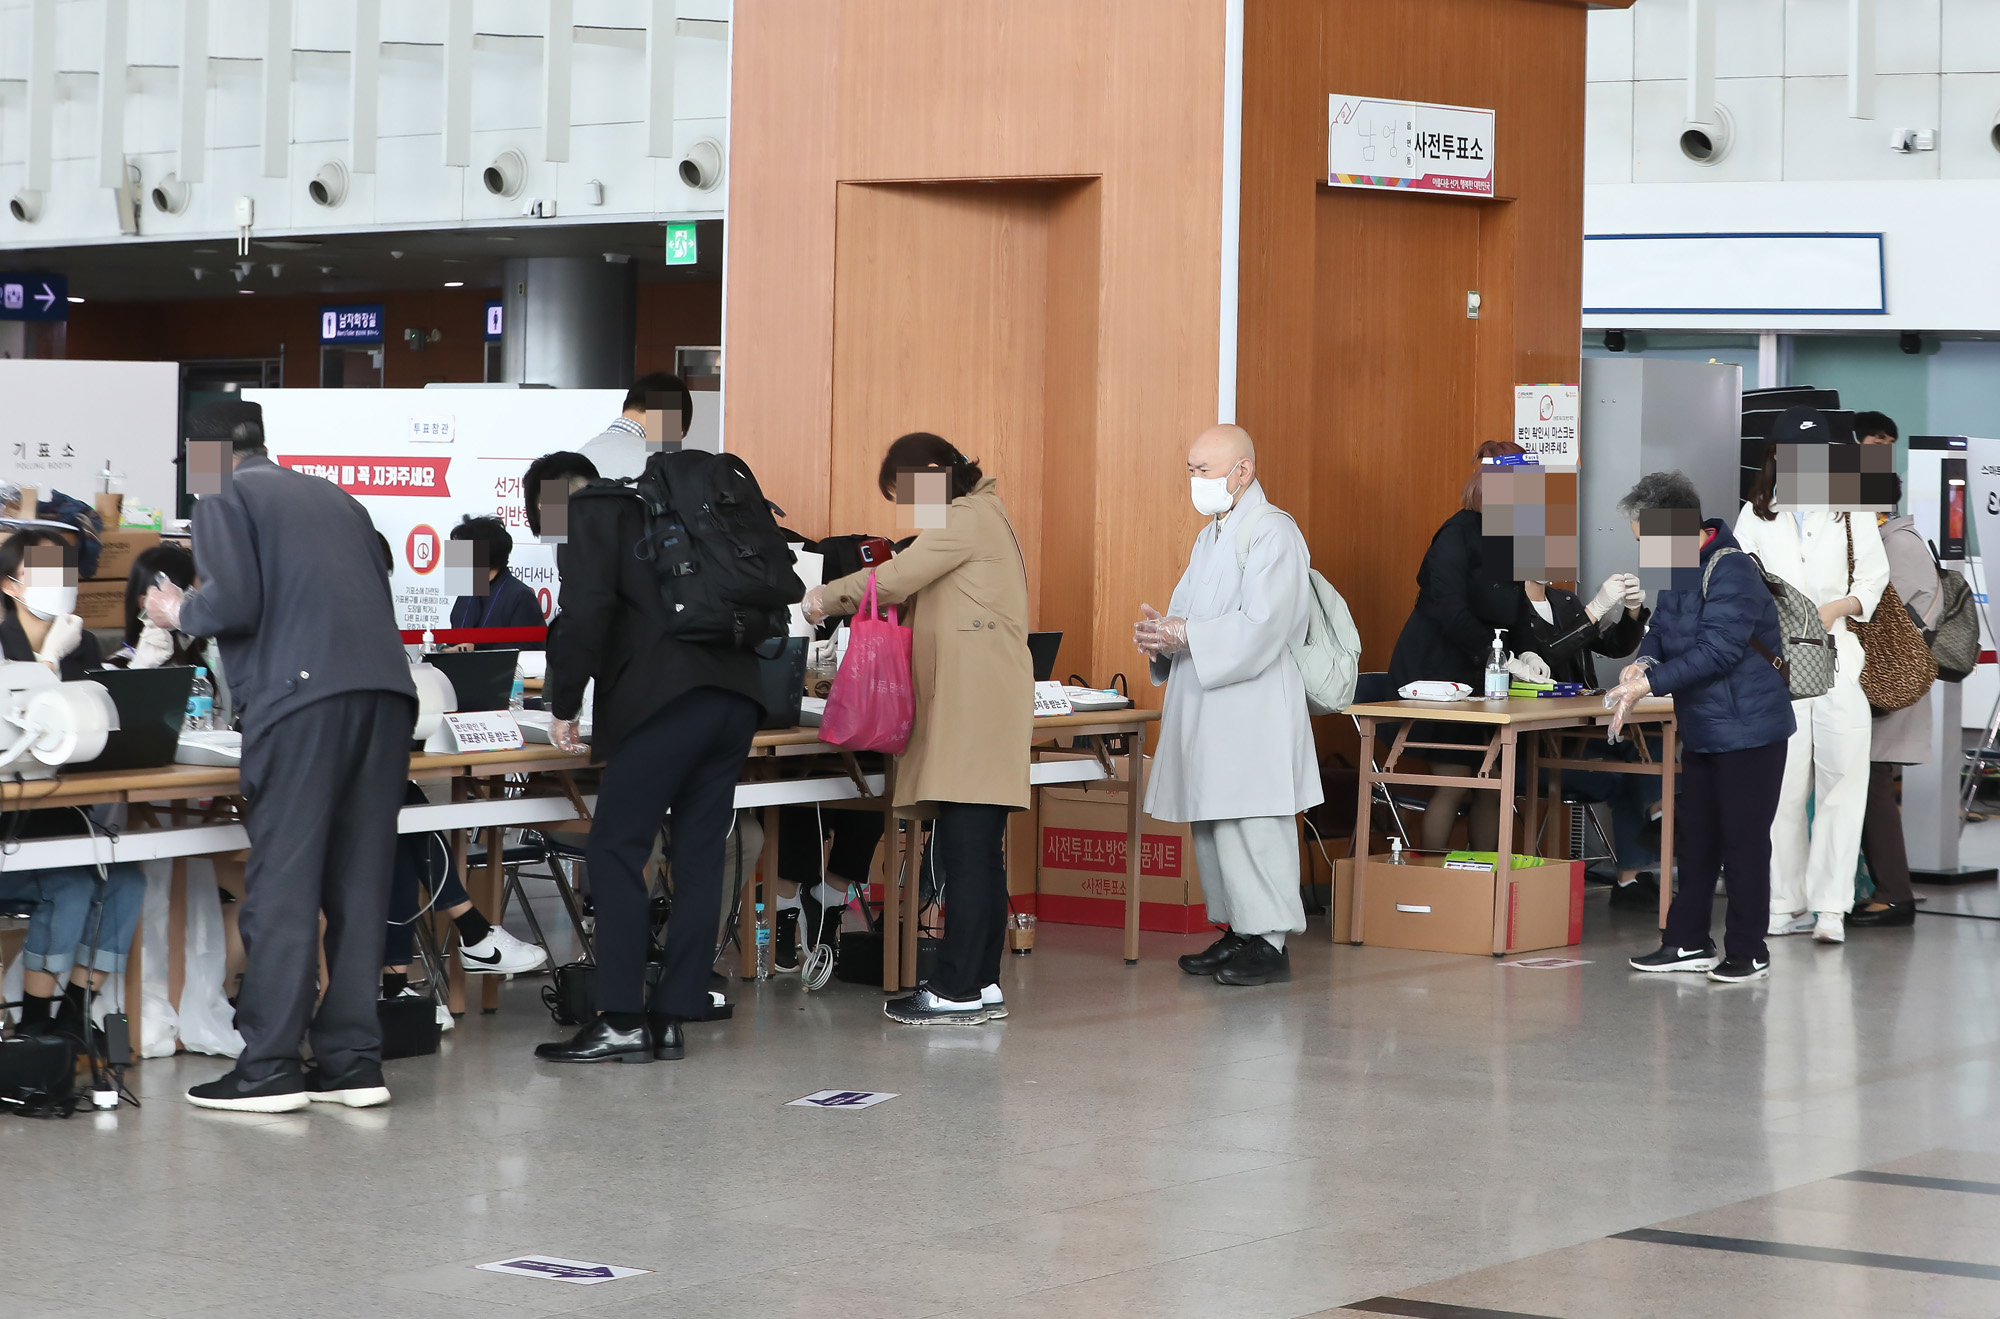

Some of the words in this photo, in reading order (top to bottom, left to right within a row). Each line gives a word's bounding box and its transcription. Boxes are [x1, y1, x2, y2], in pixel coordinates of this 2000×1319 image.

[1414, 131, 1484, 160] 사전투표소
[1432, 177, 1449, 188] 아름다운
[1460, 179, 1473, 190] 행복한
[1473, 180, 1490, 191] 대한민국
[339, 312, 377, 328] 남자화장실
[1518, 427, 1530, 440] 본인
[1532, 426, 1550, 440] 확인시
[1552, 427, 1574, 439] 마스크는
[1539, 441, 1568, 454] 내려주세요
[357, 466, 370, 485] 꼭
[373, 466, 435, 487] 지켜주세요
[494, 477, 526, 498] 선거
[395, 595, 419, 603] 기표용구를
[407, 605, 421, 613] 도장을
[404, 614, 414, 622] 다른
[415, 614, 429, 622] 표시를
[1049, 700, 1062, 709] 받는
[454, 722, 480, 732] 본인확인
[480, 722, 488, 731] 및
[459, 732, 489, 745] 투표용지
[488, 731, 496, 743] 등
[495, 730, 510, 742] 받는
[510, 730, 518, 742] 곳
[1048, 836, 1176, 870] 사전투표소방역품세트
